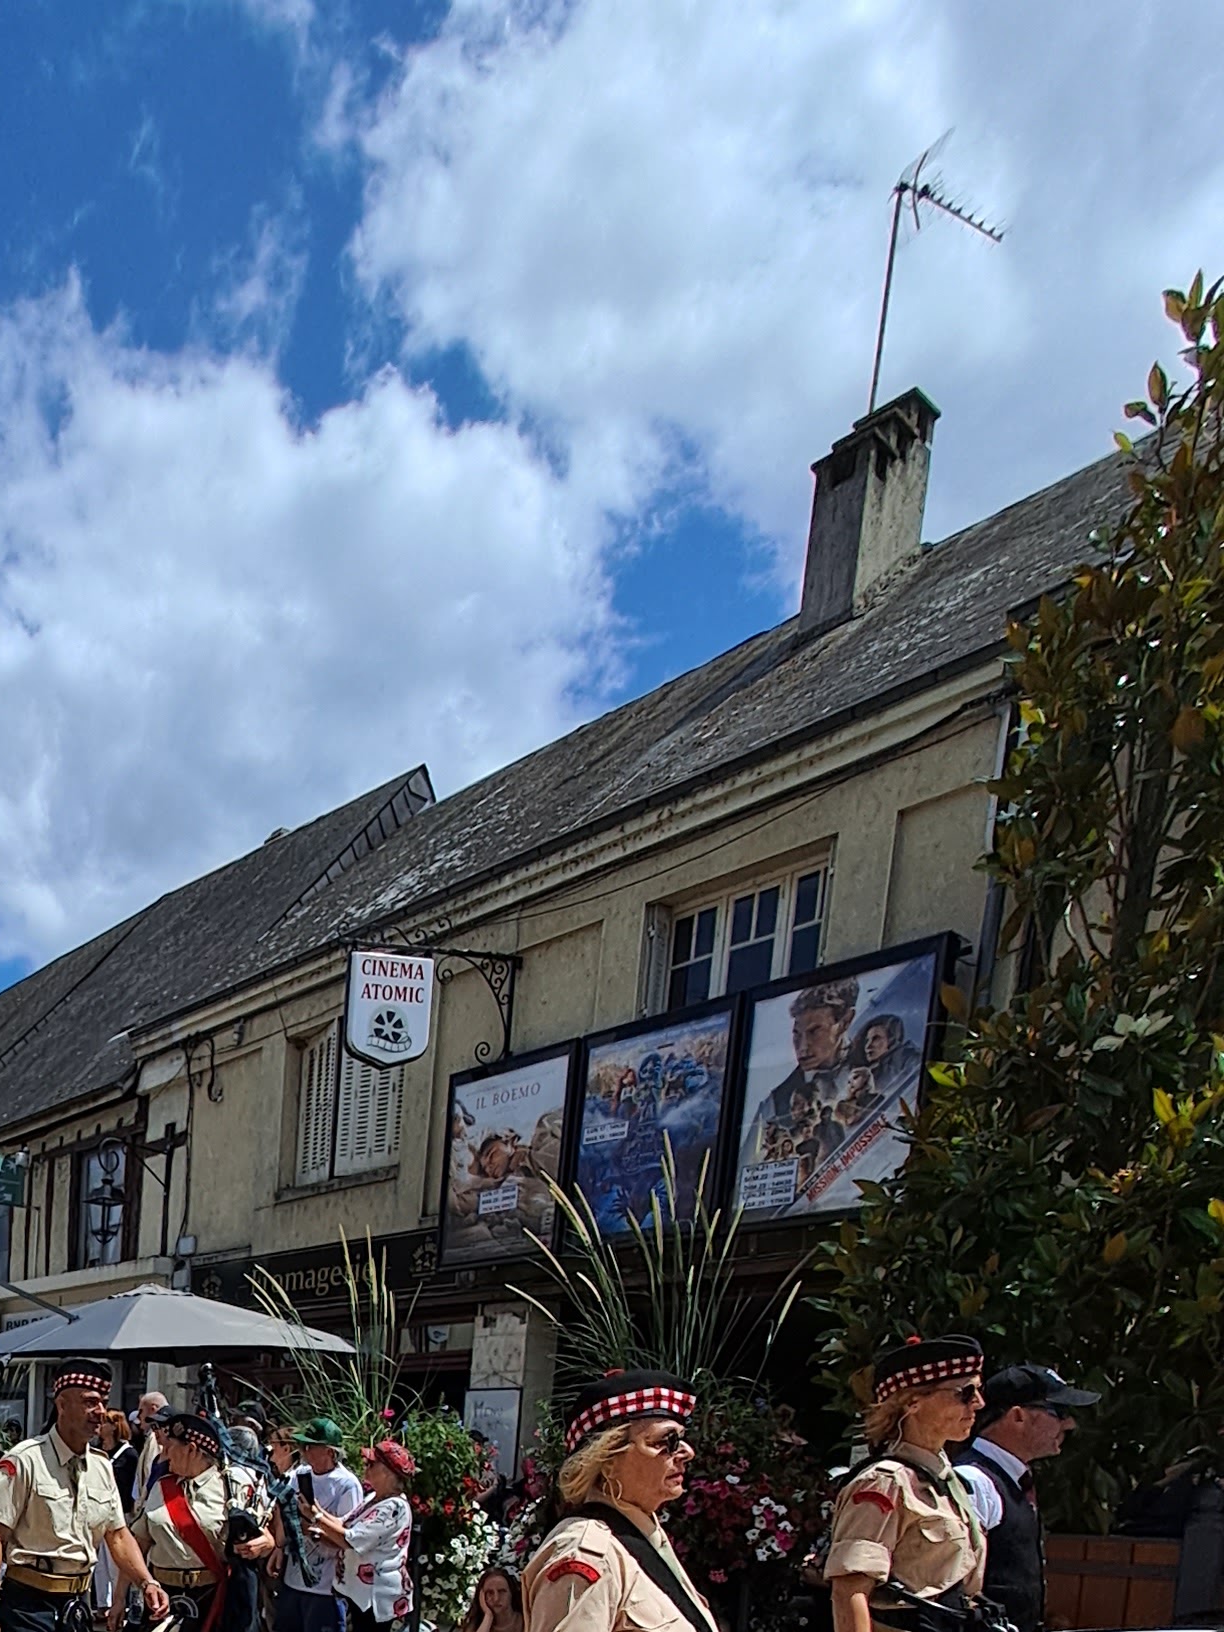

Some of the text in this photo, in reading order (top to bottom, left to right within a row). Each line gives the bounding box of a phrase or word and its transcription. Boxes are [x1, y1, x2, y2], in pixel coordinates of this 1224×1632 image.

[361, 959, 424, 980] CINEMA
[361, 983, 425, 1004] ATOMIC
[476, 1098, 487, 1110] IL
[492, 1082, 541, 1106] BOEMO
